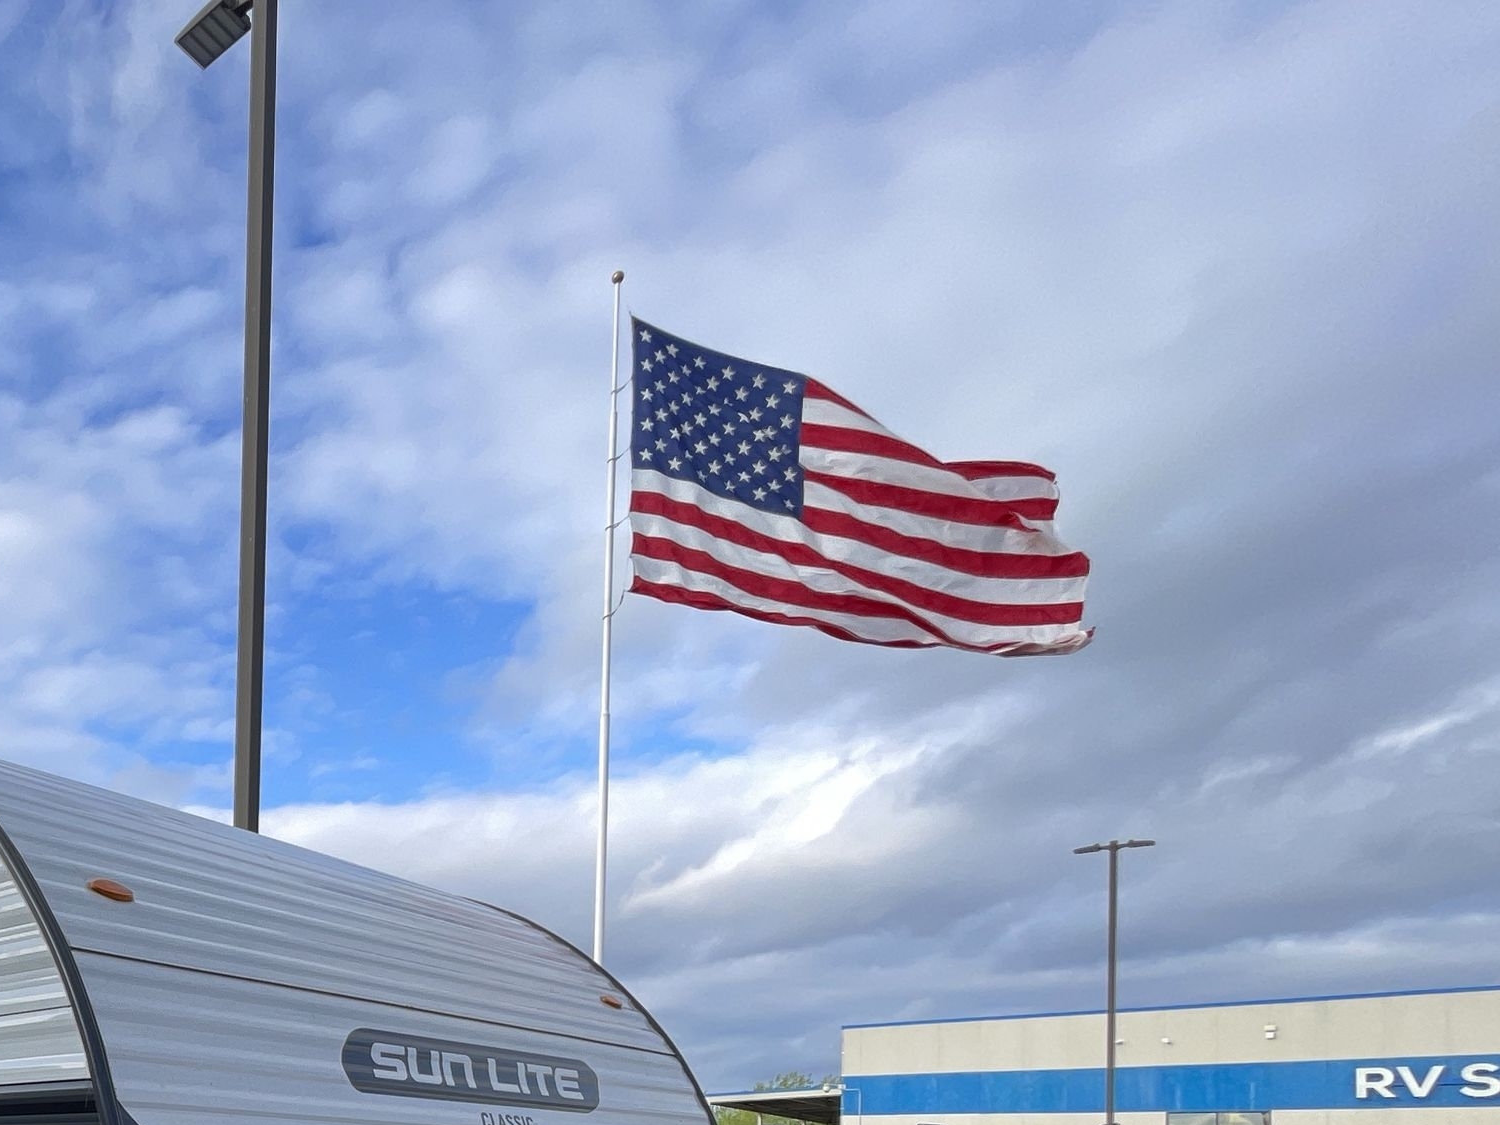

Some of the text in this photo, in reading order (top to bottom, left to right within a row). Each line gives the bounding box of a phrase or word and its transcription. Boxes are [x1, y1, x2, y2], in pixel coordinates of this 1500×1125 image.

[370, 1042, 585, 1101] SUN LITE
[1355, 1062, 1500, 1099] RV S
